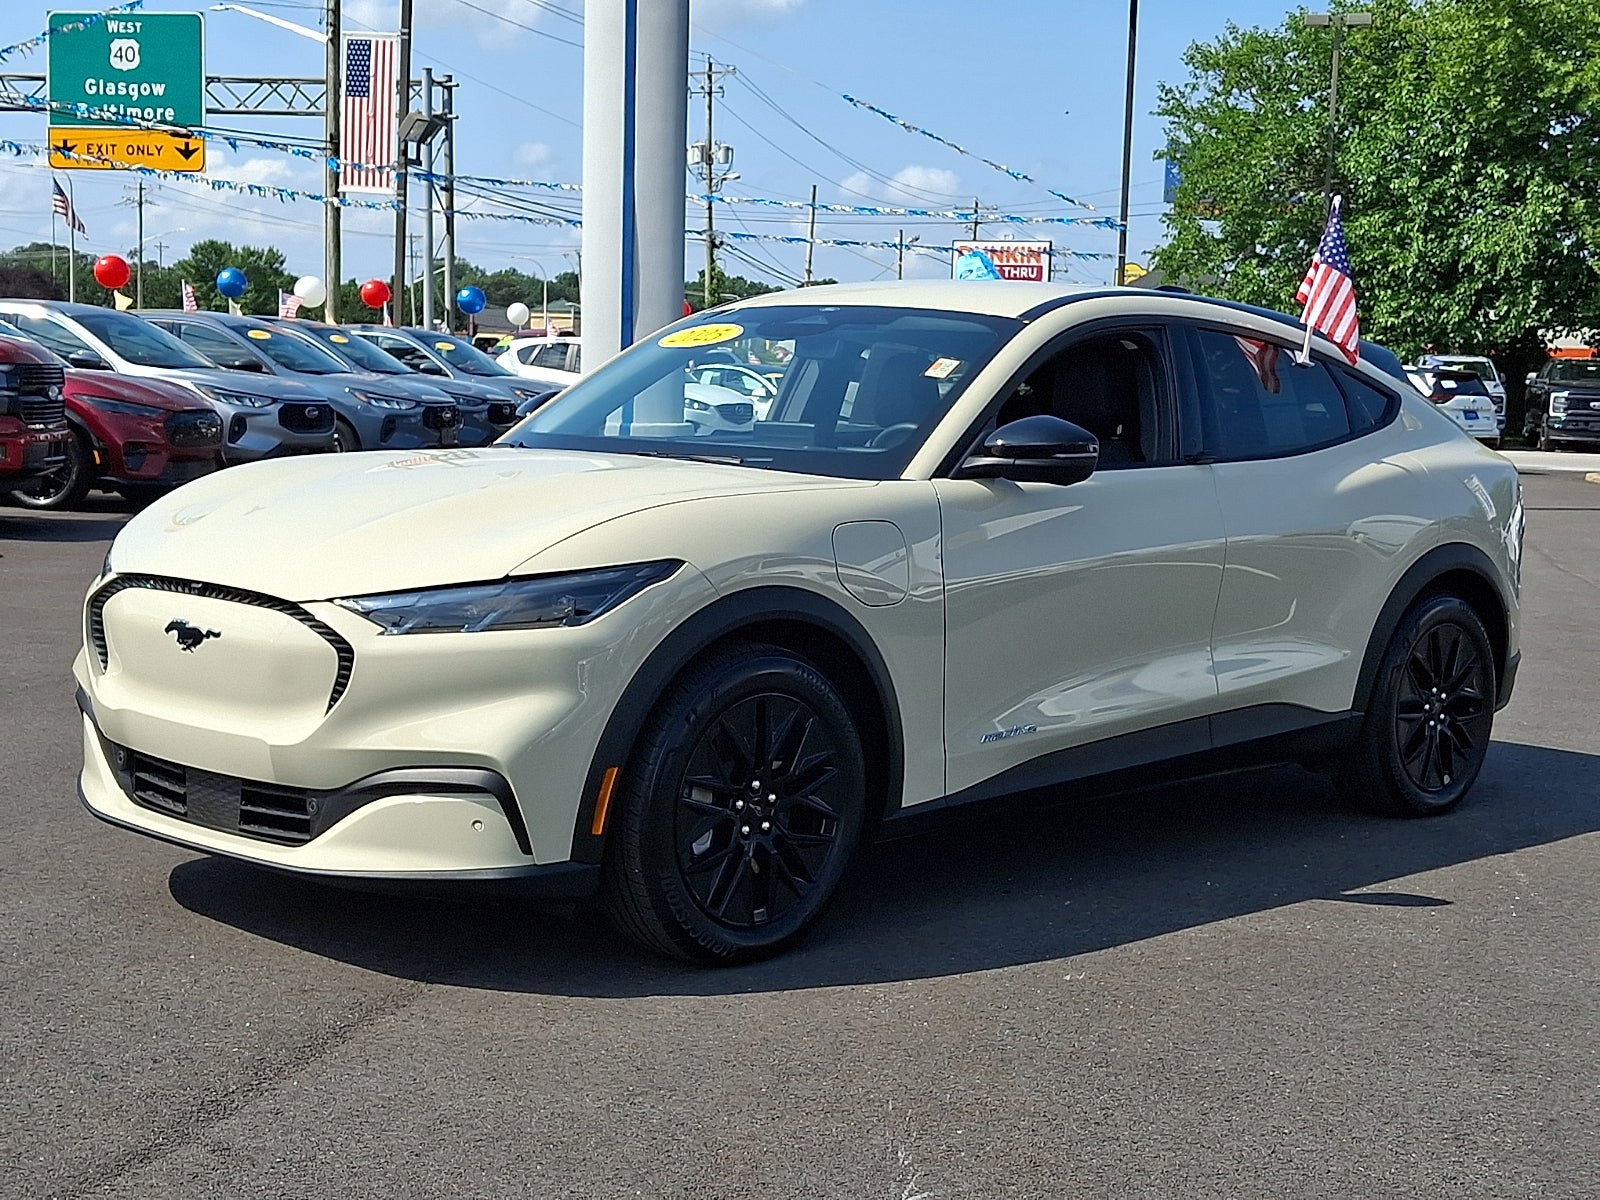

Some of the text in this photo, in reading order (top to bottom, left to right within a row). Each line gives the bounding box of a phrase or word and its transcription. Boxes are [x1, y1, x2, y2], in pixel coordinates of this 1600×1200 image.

[106, 20, 142, 34] WEST
[113, 46, 136, 62] 40
[84, 78, 166, 101] Glasgow
[86, 143, 164, 156] EXIT ONLY
[1003, 267, 1037, 279] THRU
